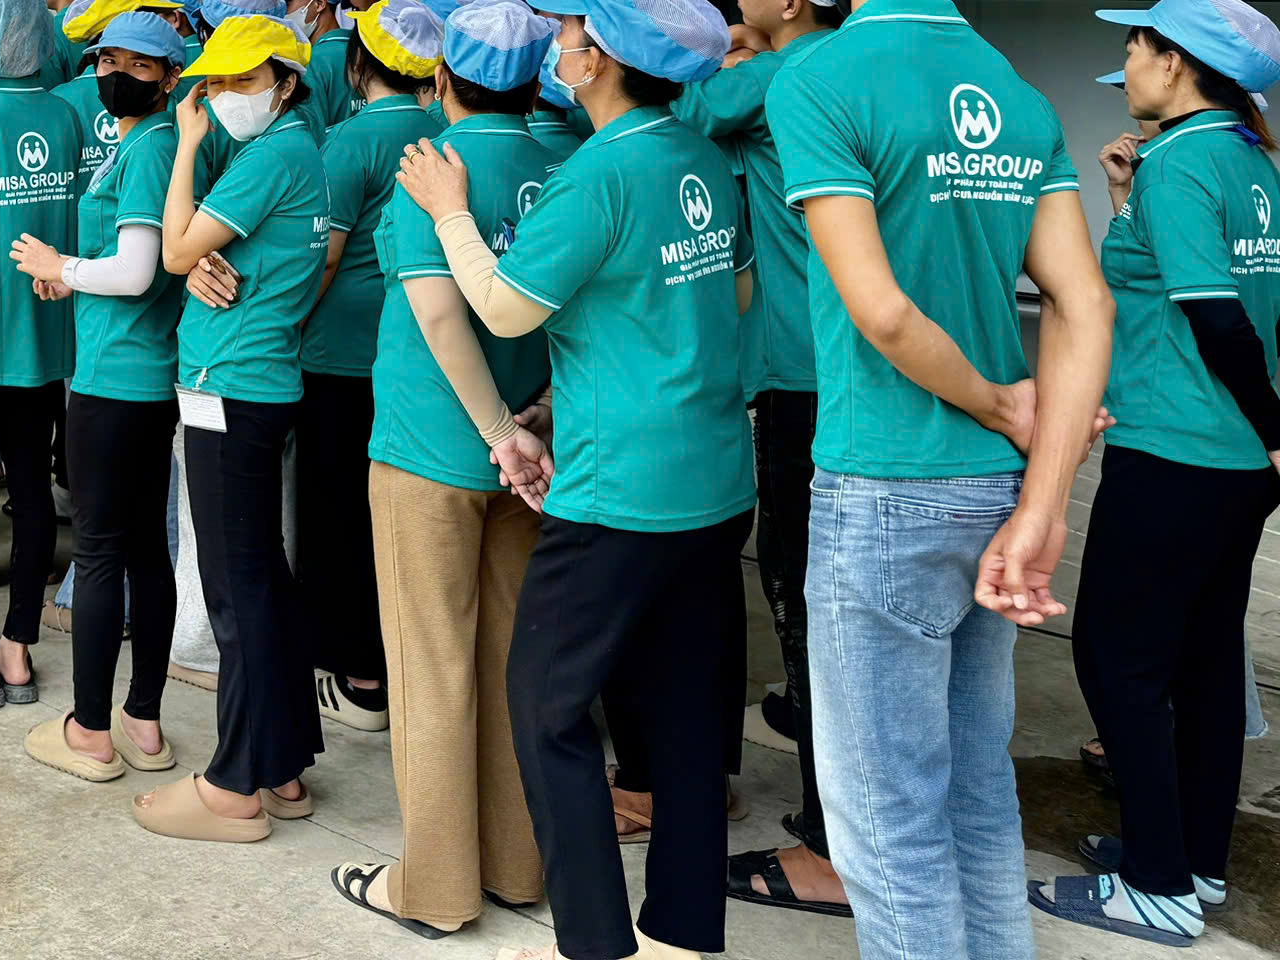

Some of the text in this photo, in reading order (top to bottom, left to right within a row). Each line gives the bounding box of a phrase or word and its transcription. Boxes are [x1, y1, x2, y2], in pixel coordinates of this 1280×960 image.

[351, 99, 367, 111] MIS
[29, 172, 74, 188] GROUP
[660, 226, 736, 265] MISA GROP
